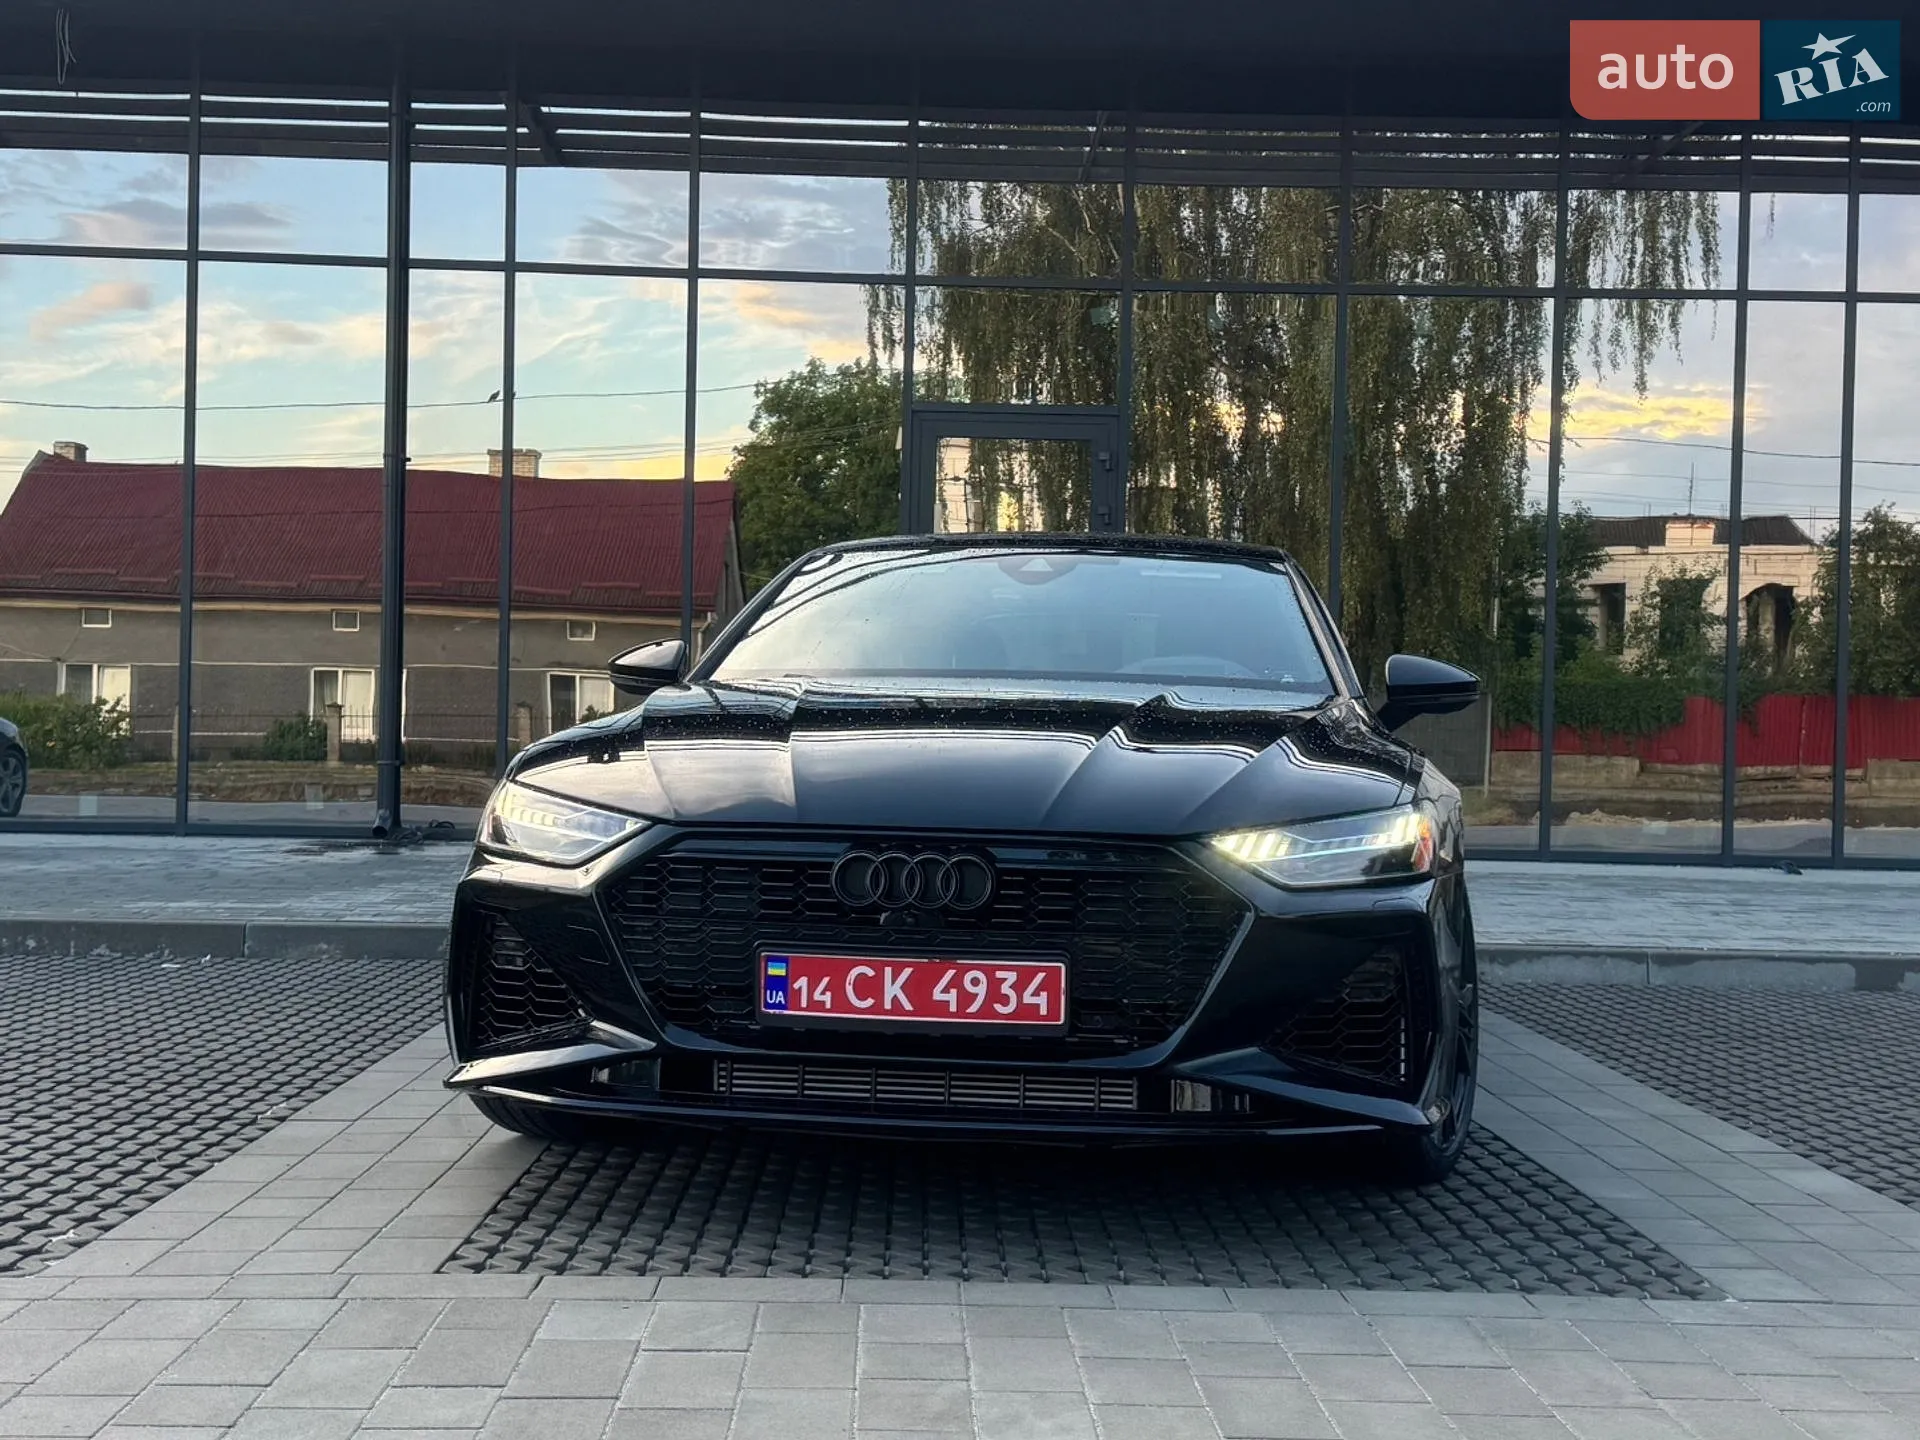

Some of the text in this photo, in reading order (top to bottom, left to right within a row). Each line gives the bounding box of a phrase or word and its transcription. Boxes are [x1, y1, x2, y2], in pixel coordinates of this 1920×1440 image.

[766, 989, 785, 1005] UA
[792, 965, 1049, 1016] 14 CK 4934
